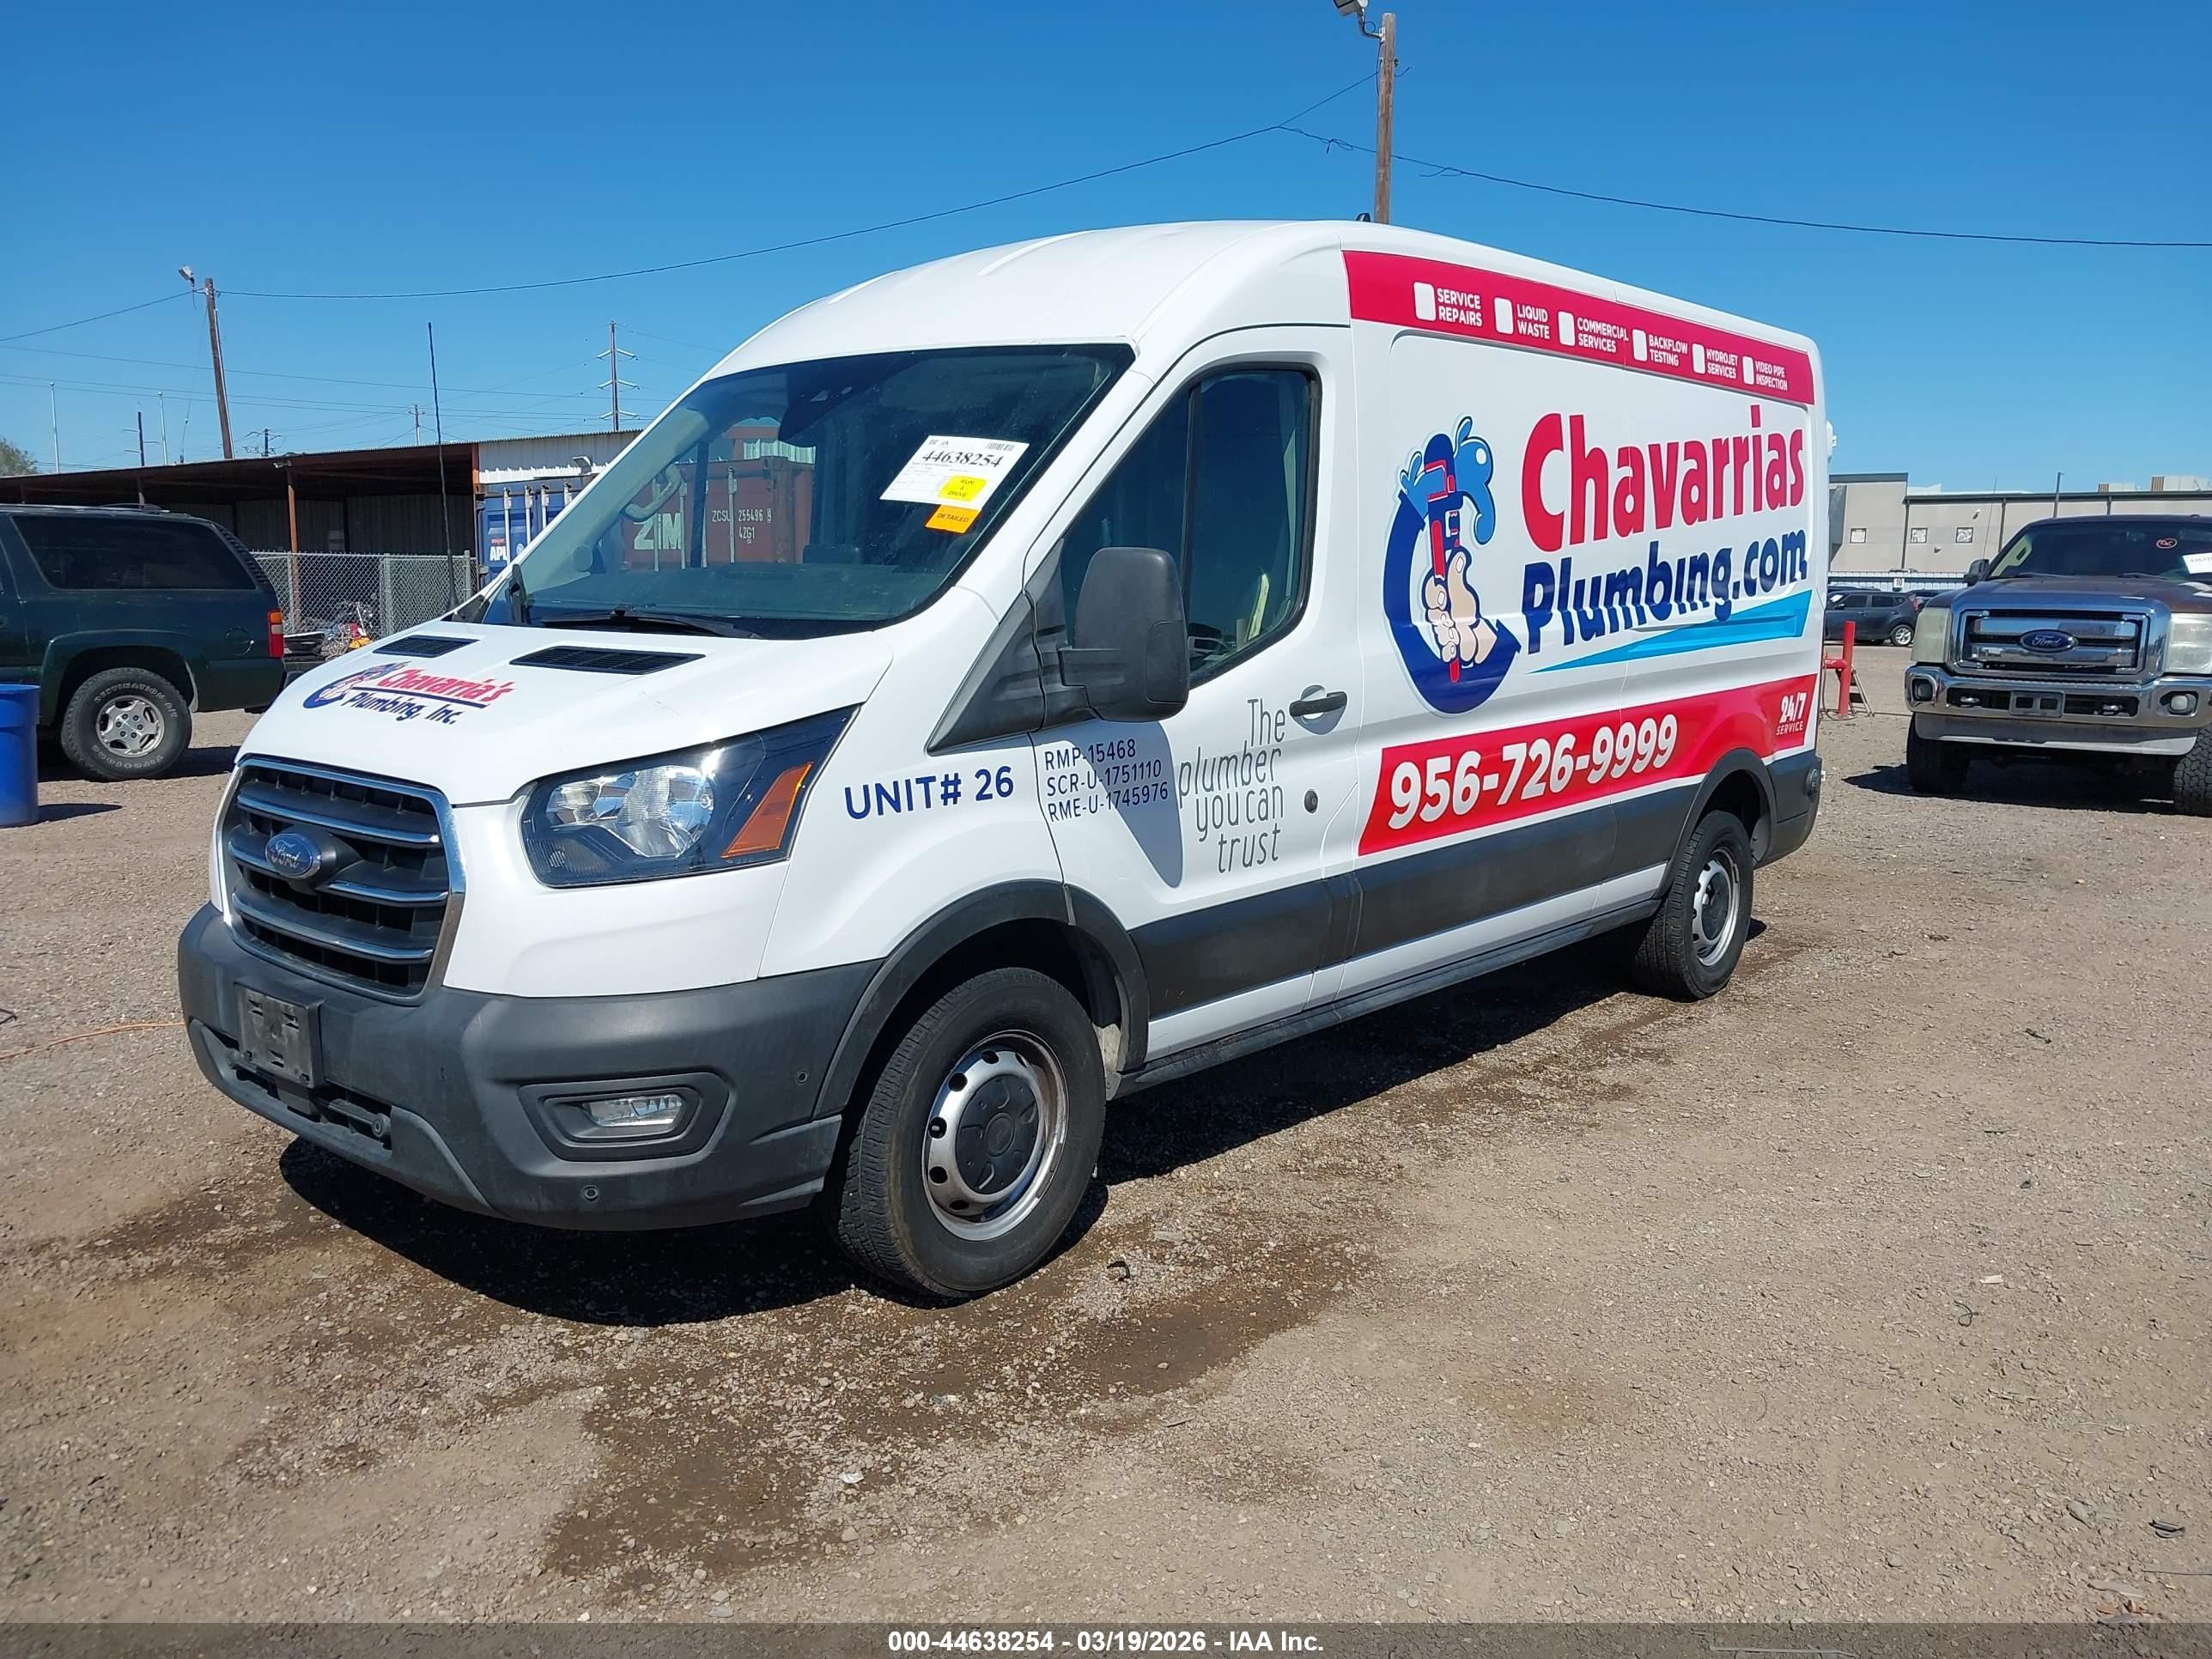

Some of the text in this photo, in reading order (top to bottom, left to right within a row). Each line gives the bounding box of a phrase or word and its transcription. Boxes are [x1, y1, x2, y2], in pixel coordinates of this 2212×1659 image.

[1437, 288, 1481, 310] SERVICE
[1438, 305, 1483, 327] REPAIRS
[1516, 303, 1549, 323] LIQUID
[1516, 319, 1551, 340] WASTE
[1577, 317, 1630, 342] COMMERCIAL
[1578, 332, 1617, 353] SERVICES
[1648, 334, 1688, 355] BACKFLOW
[1649, 349, 1680, 368] TESTING
[1705, 348, 1739, 367] HYDROJET
[1707, 362, 1737, 380] SERVICES
[1754, 360, 1785, 379] VIDEO PIPE
[1755, 374, 1789, 392] INSPECTION
[922, 450, 1004, 468] 44638254
[1522, 404, 1804, 553] Chavarrias
[738, 508, 763, 522] 255496
[937, 513, 969, 523] DETAILED
[738, 526, 755, 539] 42G1
[489, 545, 508, 562] APL
[1522, 529, 1808, 655] Plumbing.com
[2032, 634, 2062, 647] Ford
[341, 691, 465, 725] Plumbing, Inc.
[1778, 691, 1808, 724] 24/7
[1247, 698, 1286, 747] The
[1776, 720, 1804, 736] SERVICE
[1044, 738, 1137, 772] RMP-15468
[1046, 758, 1163, 797] SCR-U-1751110
[1178, 739, 1282, 809] plumber
[1388, 714, 1678, 830] 956-726-9999
[844, 765, 1014, 820] UNIT# 26
[1048, 781, 1169, 823] RME-U-1745976
[1195, 785, 1285, 842] you can
[1217, 822, 1281, 874] trust
